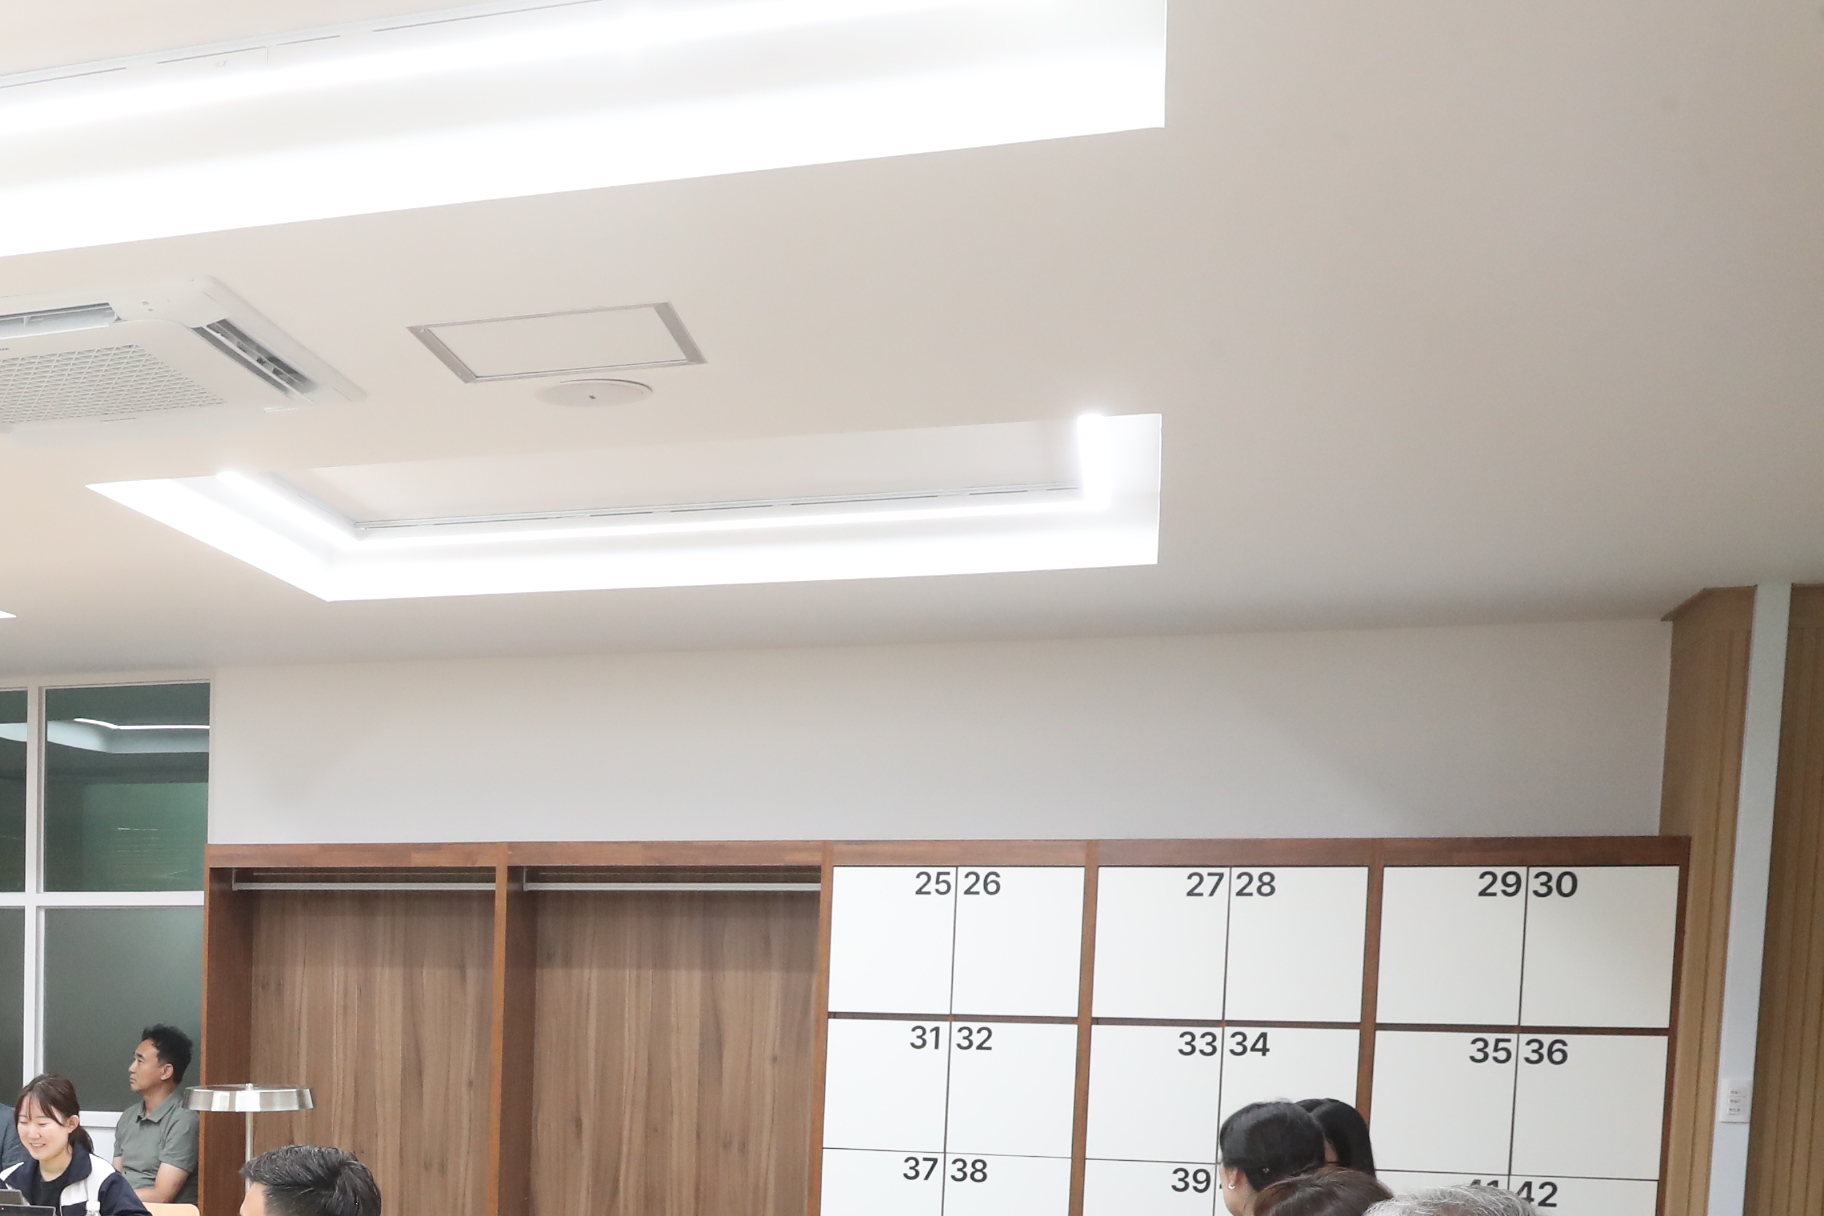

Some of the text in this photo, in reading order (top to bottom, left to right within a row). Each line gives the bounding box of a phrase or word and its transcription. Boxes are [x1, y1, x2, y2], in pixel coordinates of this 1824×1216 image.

[916, 872, 950, 895] 25
[965, 872, 1001, 895] 26
[1186, 872, 1224, 896] 27
[1236, 872, 1276, 897] 28
[1478, 871, 1521, 897] 29
[1532, 871, 1578, 898] 30
[911, 1026, 940, 1050] 31
[956, 1027, 992, 1051] 32
[1178, 1032, 1217, 1056] 33
[1229, 1032, 1270, 1056] 34
[1469, 1038, 1512, 1064] 35
[1523, 1038, 1568, 1065] 36
[904, 1157, 938, 1180] 37
[950, 1158, 988, 1182] 38
[1171, 1167, 1211, 1194] 39
[1516, 1180, 1558, 1208] 42
